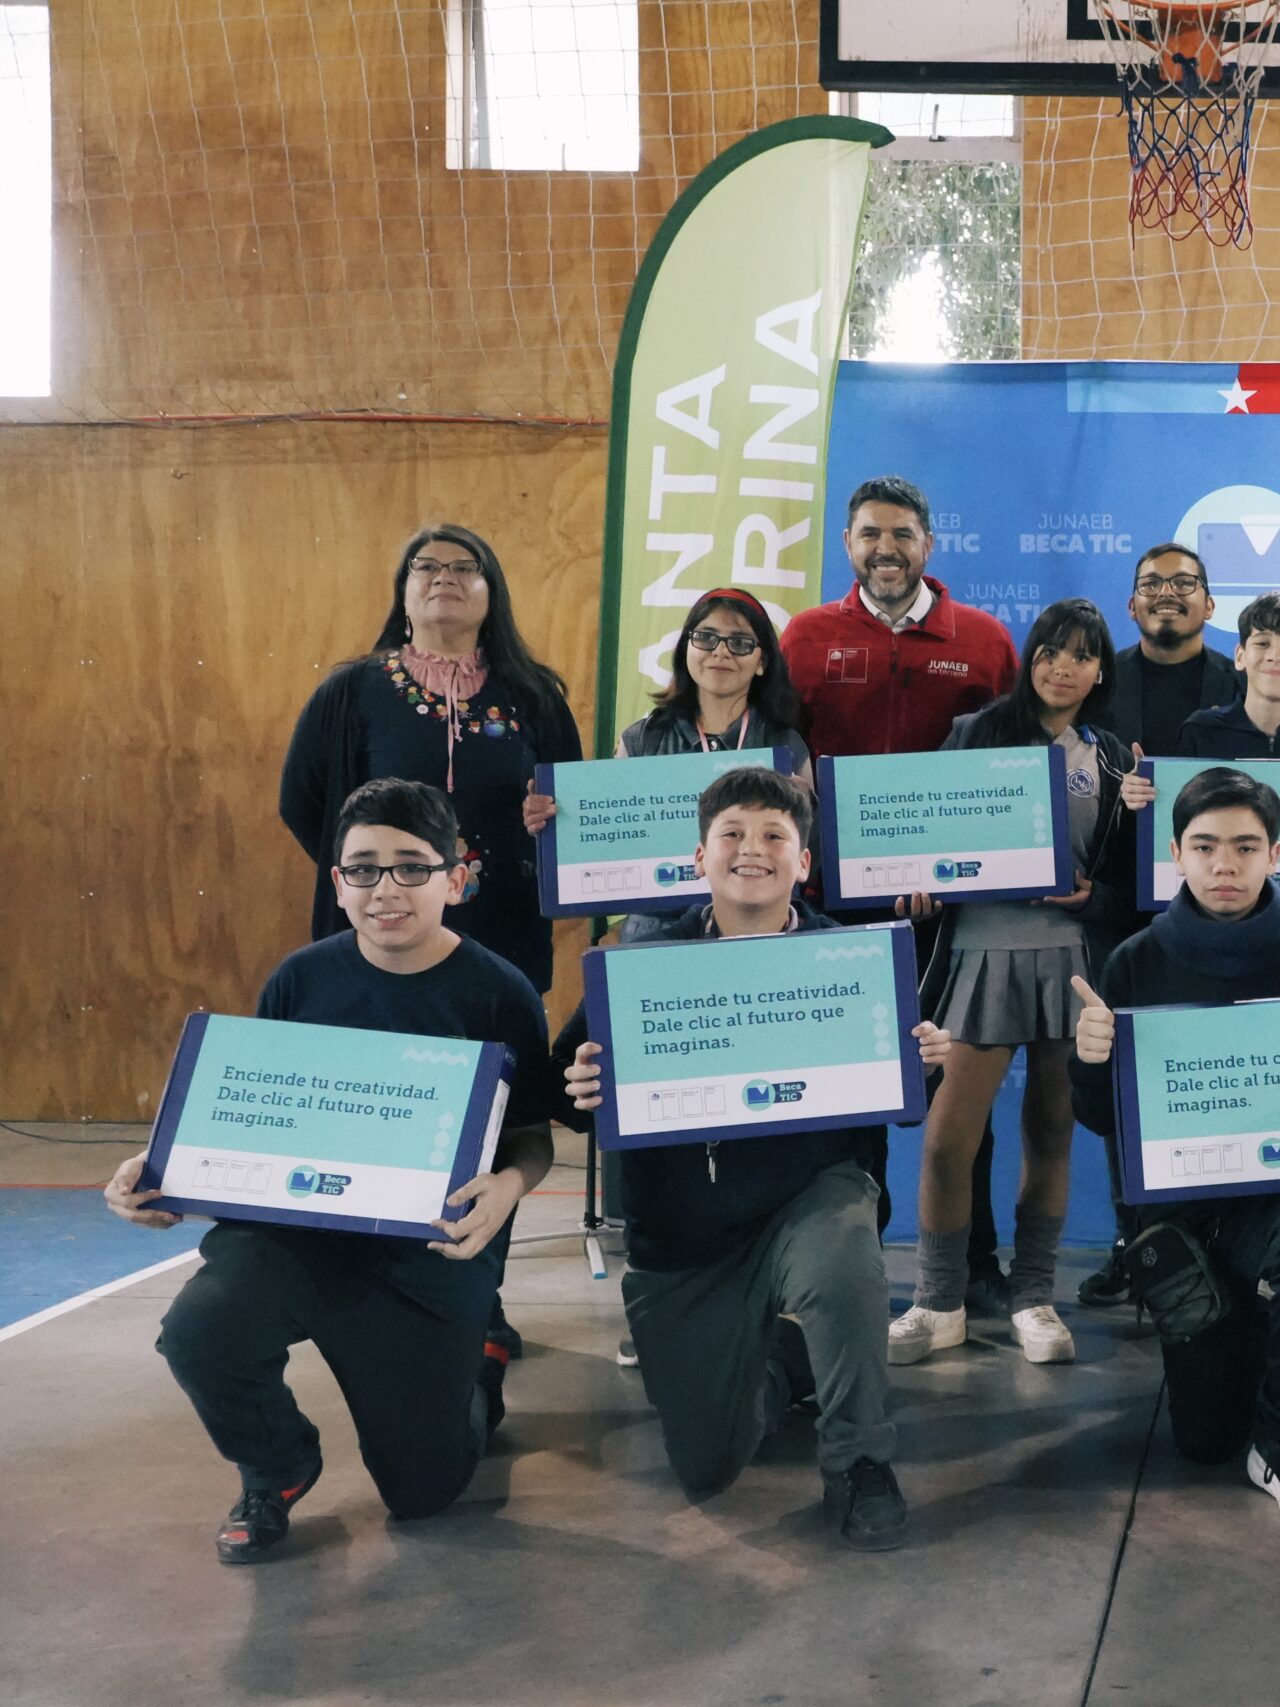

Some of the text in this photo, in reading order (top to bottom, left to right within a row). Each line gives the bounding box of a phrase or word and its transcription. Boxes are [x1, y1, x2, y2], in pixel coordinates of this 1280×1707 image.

[929, 513, 961, 529] AEB
[1038, 513, 1113, 530] JUNAEB
[1019, 533, 1133, 554] BECA TIC
[964, 583, 1040, 600] JUNAEB
[1014, 603, 1043, 624] TI
[928, 660, 969, 672] JUNAEB
[579, 796, 645, 810] Enciende
[650, 795, 663, 805] tu
[859, 786, 1028, 805] Enciende tu creatividad.
[580, 808, 698, 827] Dale clic al futur
[860, 804, 1012, 821] Dale clic al futuro que
[580, 828, 650, 843] imaginas.
[861, 824, 928, 838] imaginas.
[640, 982, 865, 1013] Enciende tu creatividad.
[642, 1006, 844, 1034] Dale clic al futuro que
[644, 1037, 735, 1056] imaginas.
[1164, 1056, 1245, 1073] Enciende
[1250, 1054, 1268, 1067] tu
[222, 1066, 439, 1101] Enciende tu creatividad.
[779, 1083, 801, 1091] Beca
[1166, 1077, 1204, 1093] Dale
[1209, 1075, 1238, 1089] clic
[1244, 1073, 1258, 1087] al
[217, 1087, 413, 1122] Dale clic al futuro que
[780, 1093, 797, 1101] TIC
[1167, 1095, 1252, 1114] imaginas.
[211, 1107, 298, 1129] imaginas.
[325, 1175, 347, 1184] Beca
[322, 1186, 340, 1195] TIC
